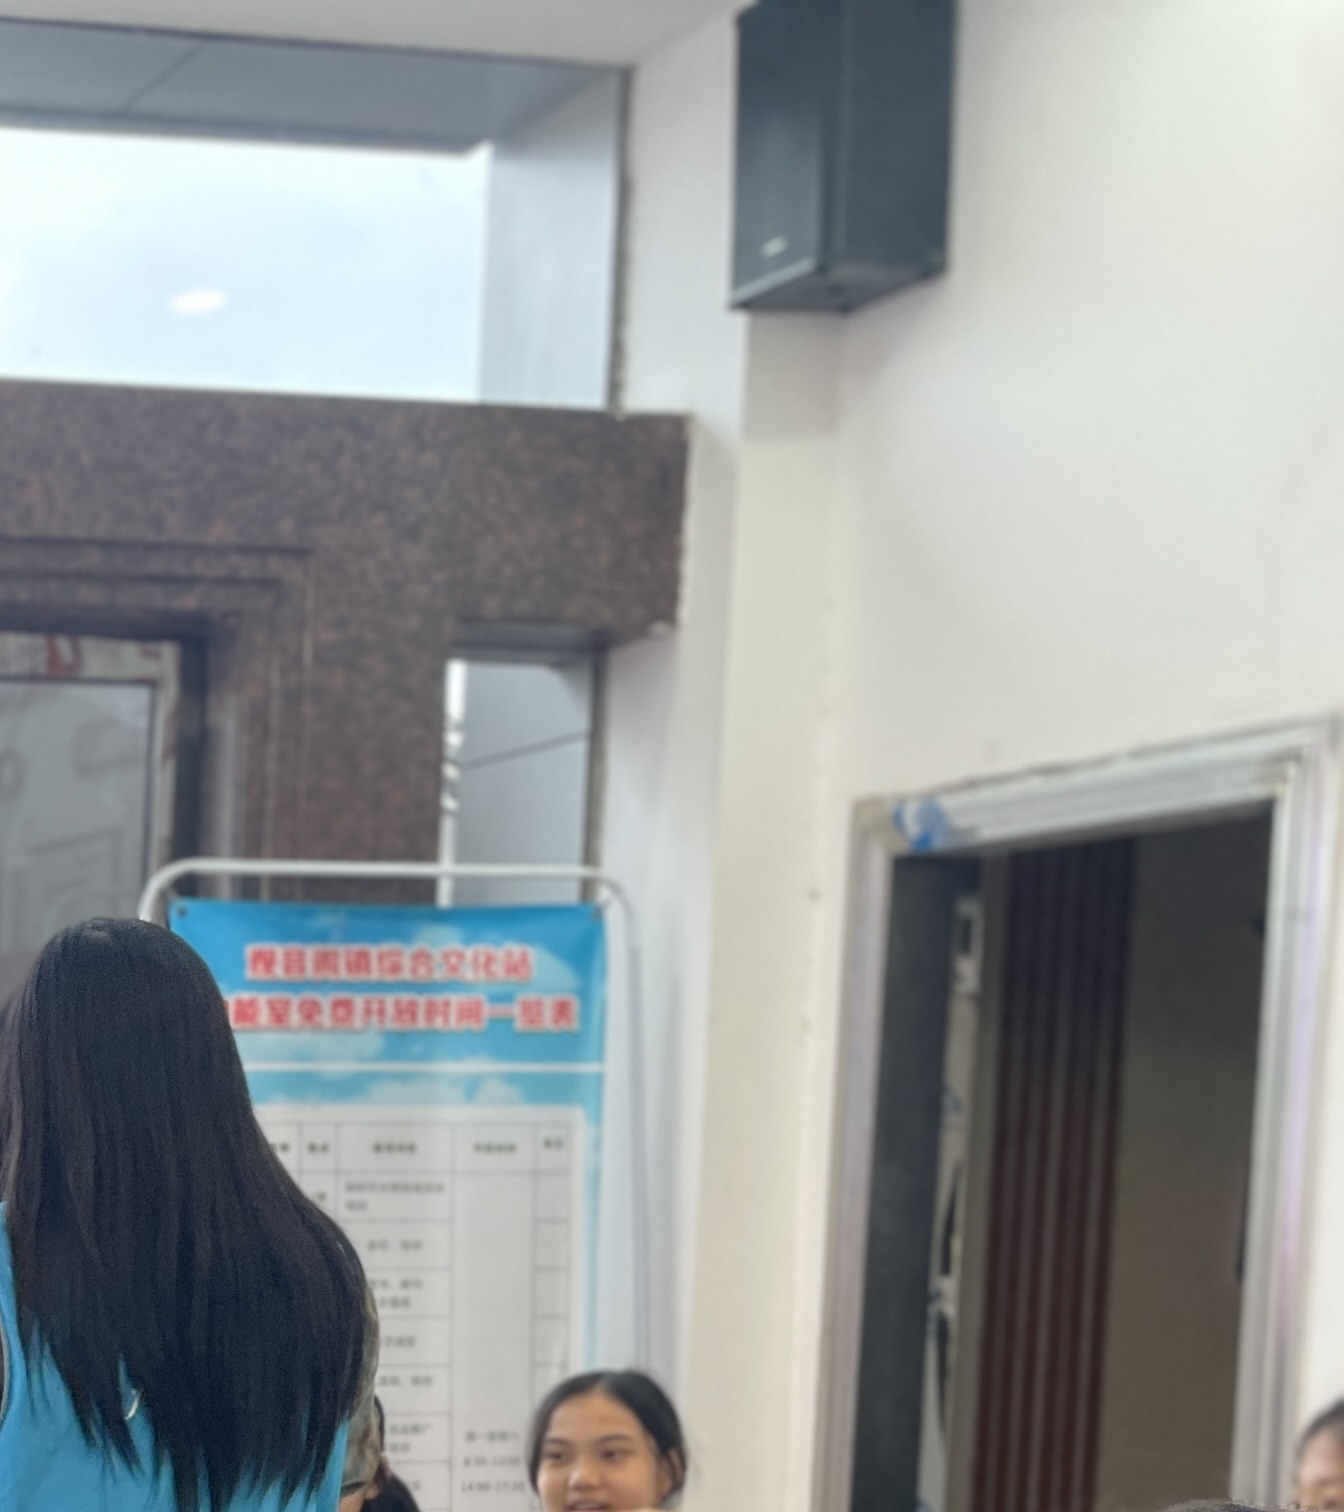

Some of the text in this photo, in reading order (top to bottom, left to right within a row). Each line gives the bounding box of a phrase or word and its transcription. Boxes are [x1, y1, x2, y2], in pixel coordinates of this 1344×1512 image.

[226, 994, 578, 1031] 能室免费开放时间一览表
